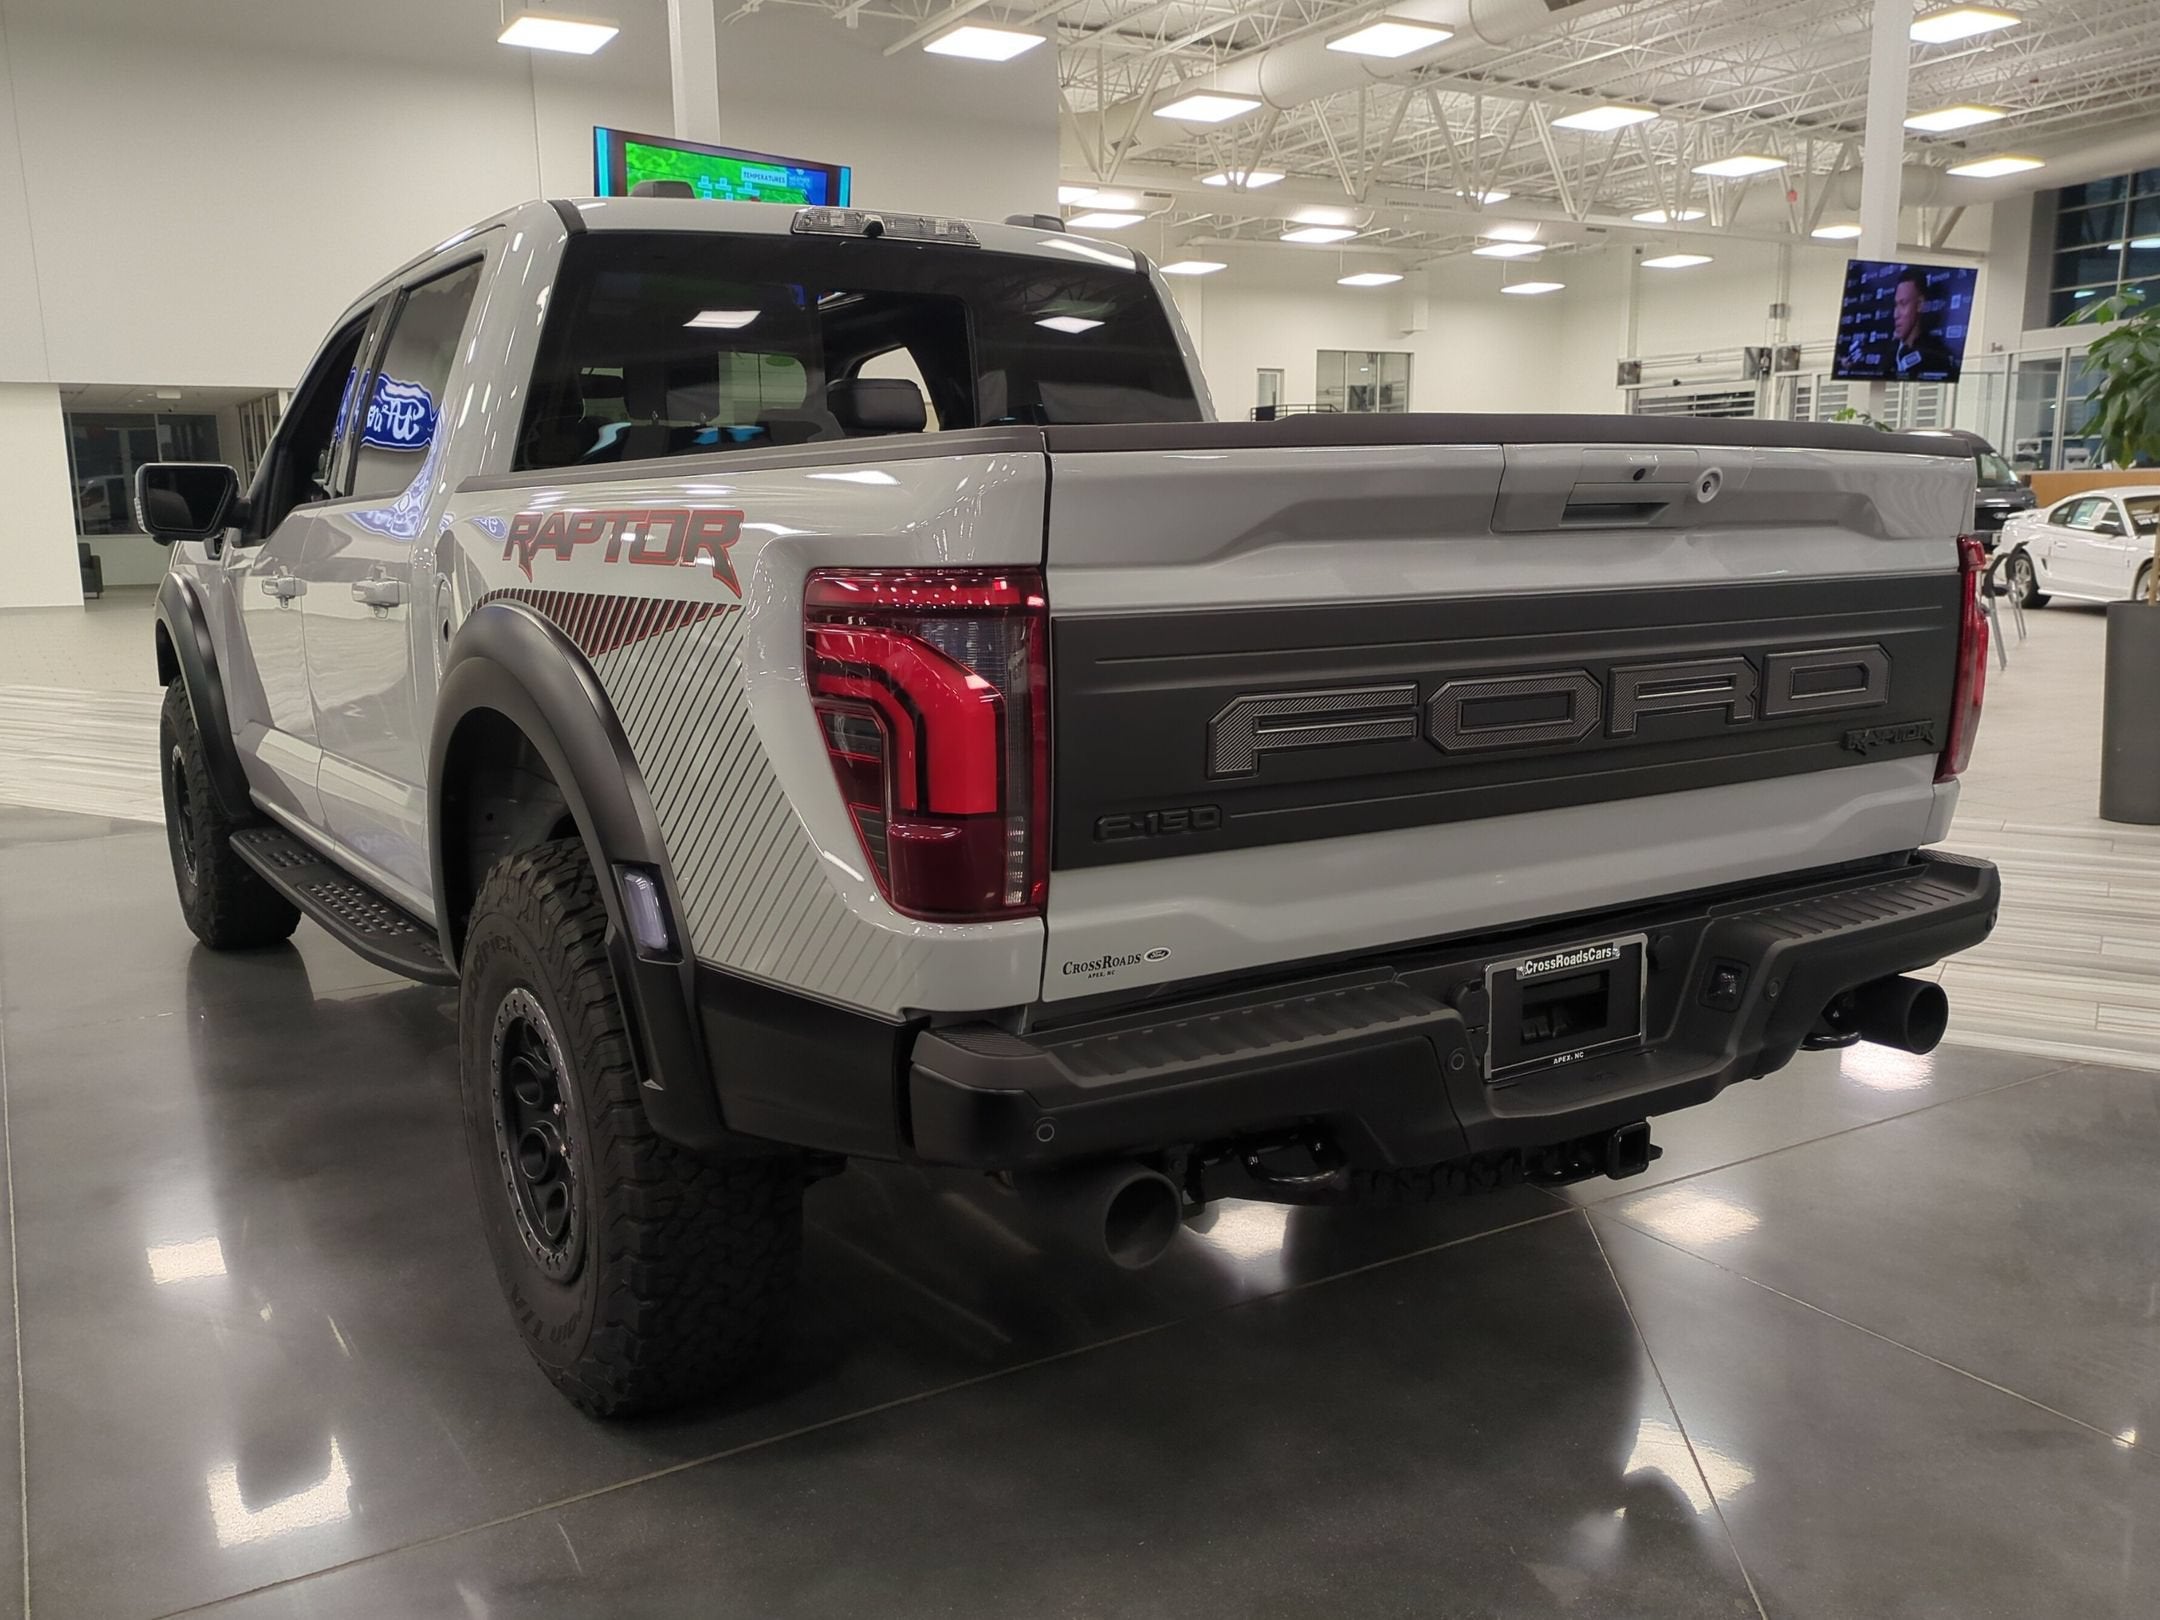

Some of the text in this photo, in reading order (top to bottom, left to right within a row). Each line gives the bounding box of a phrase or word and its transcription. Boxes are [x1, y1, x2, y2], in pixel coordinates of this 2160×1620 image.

[502, 509, 745, 600] RAPTOR
[1206, 642, 1893, 782] FORD
[1842, 719, 1935, 756] RAPTOR
[1094, 804, 1222, 843] F-150
[1525, 947, 1612, 975] CrossRoadsCars
[1574, 1051, 1585, 1060] NC
